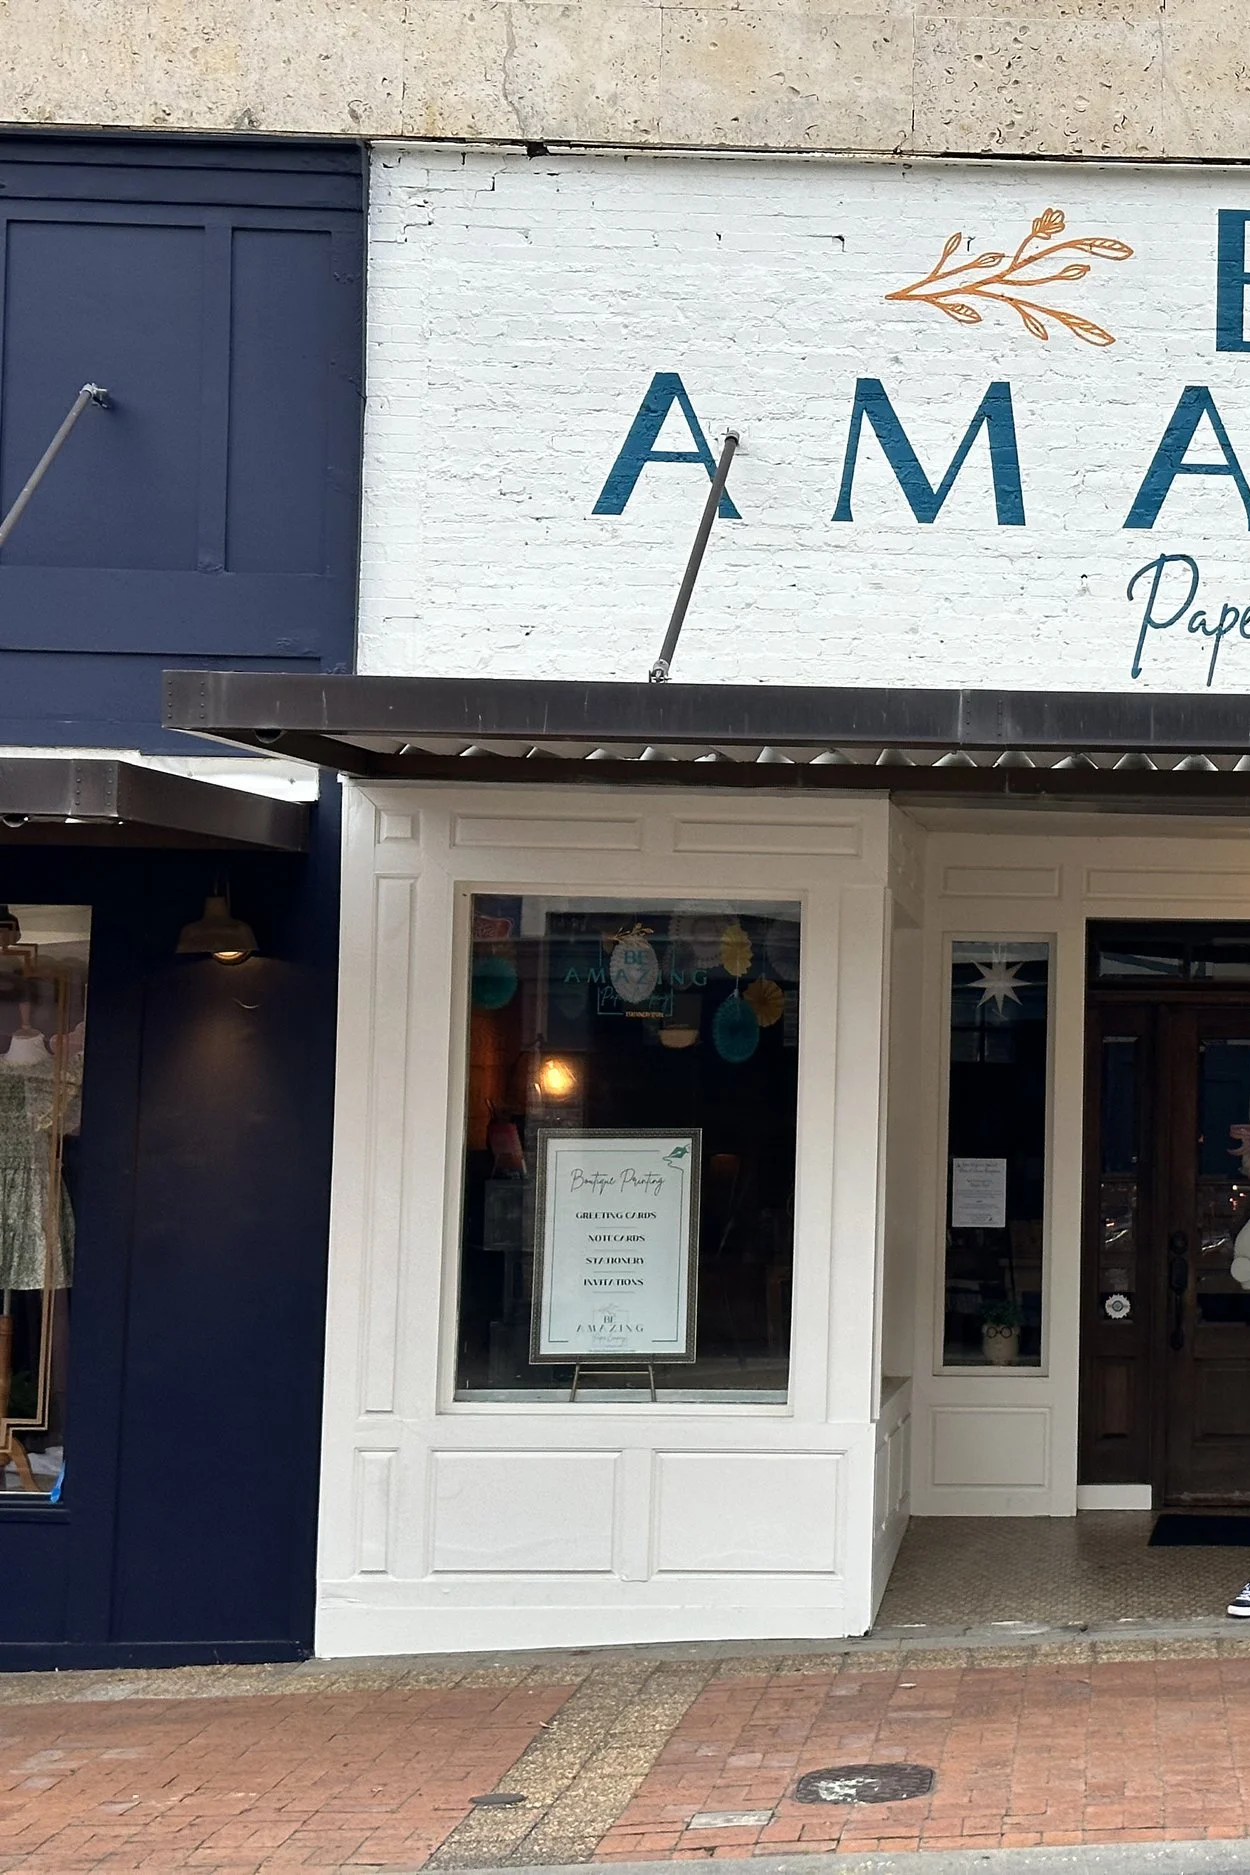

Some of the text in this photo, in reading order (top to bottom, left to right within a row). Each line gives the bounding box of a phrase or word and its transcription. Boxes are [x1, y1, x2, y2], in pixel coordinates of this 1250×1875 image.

[624, 951, 648, 965] BE
[564, 967, 708, 986] AMAZING
[571, 1168, 665, 1196] Boutique Printing
[575, 1211, 657, 1220] GREETING CARDS
[585, 1256, 645, 1265] STATIONERY
[583, 1278, 645, 1287] INVITATIONS
[576, 1324, 644, 1333] AMAZING
